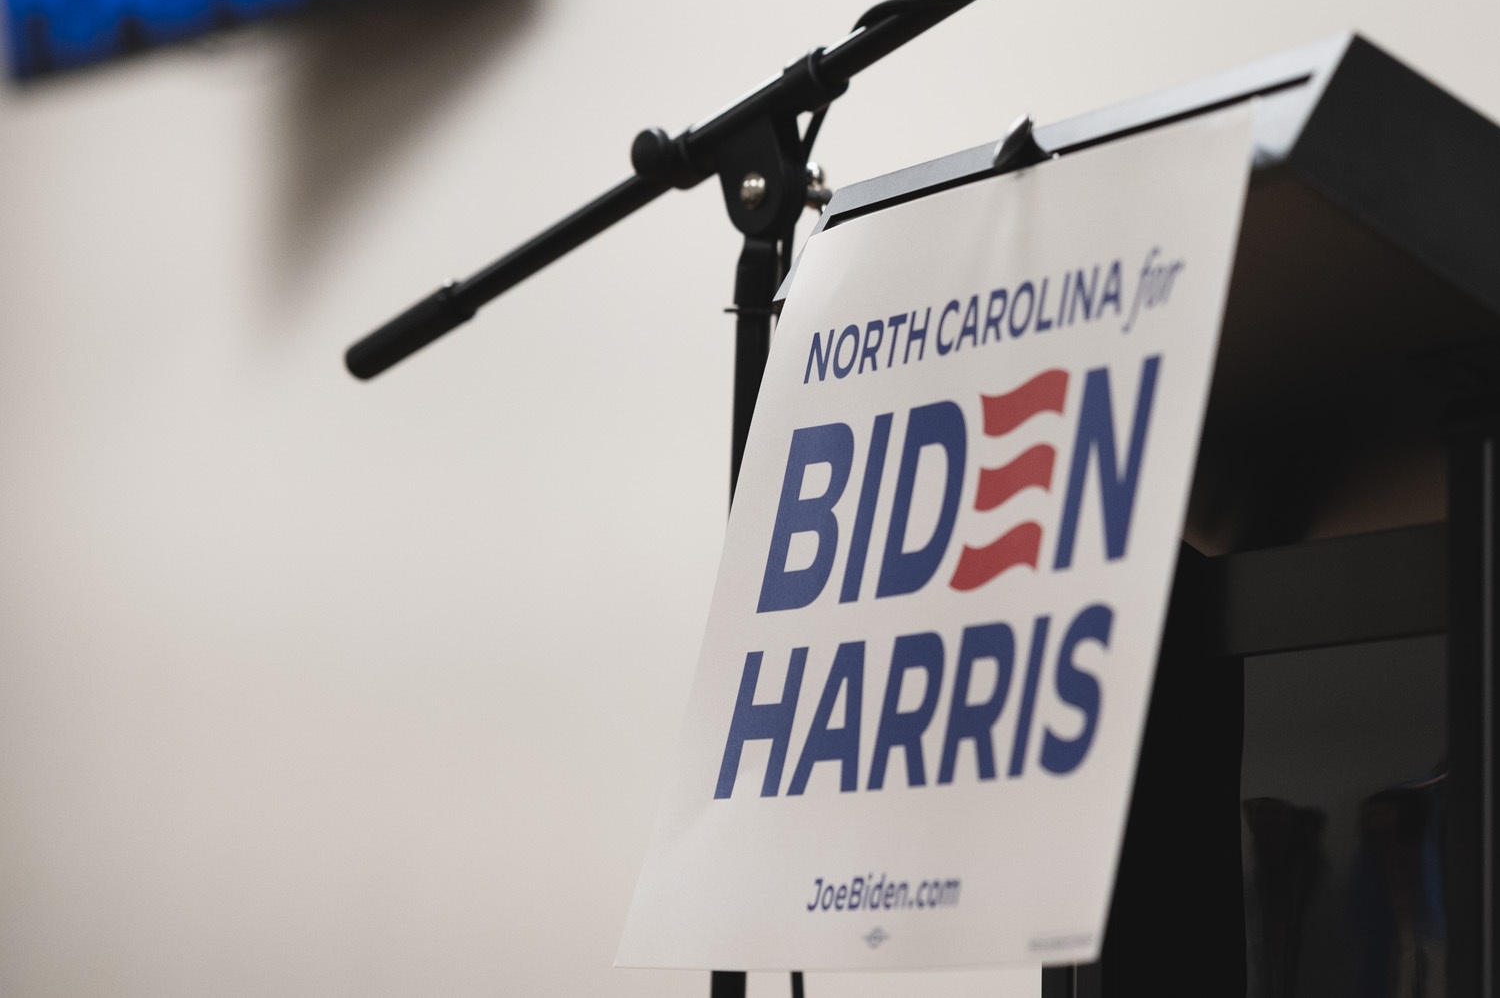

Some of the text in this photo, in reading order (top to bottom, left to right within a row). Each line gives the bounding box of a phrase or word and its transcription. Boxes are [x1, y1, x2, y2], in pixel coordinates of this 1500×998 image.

[803, 245, 1187, 385] NORTH CAROLINA for
[756, 352, 1164, 614] BIDEN
[713, 601, 1115, 800] HARRIS
[806, 873, 962, 913] JoeBiden.com
